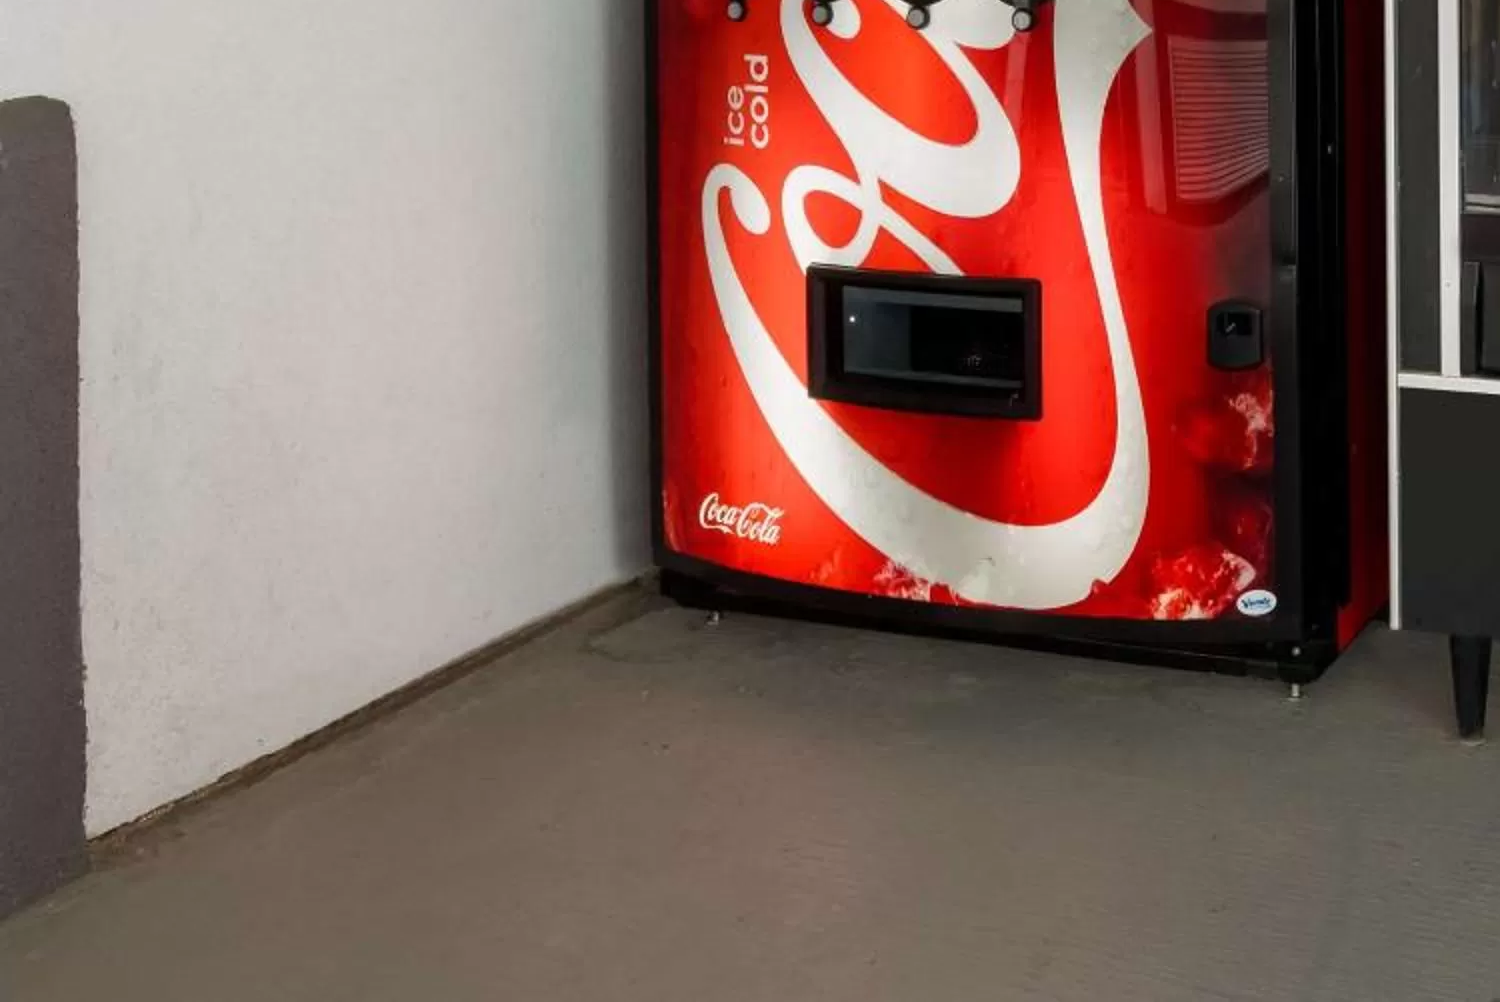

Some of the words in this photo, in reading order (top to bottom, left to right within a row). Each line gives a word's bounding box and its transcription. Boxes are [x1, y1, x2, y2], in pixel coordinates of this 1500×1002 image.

[723, 85, 745, 147] ice
[743, 53, 769, 150] cold
[699, 492, 784, 545] Coca-Cola
